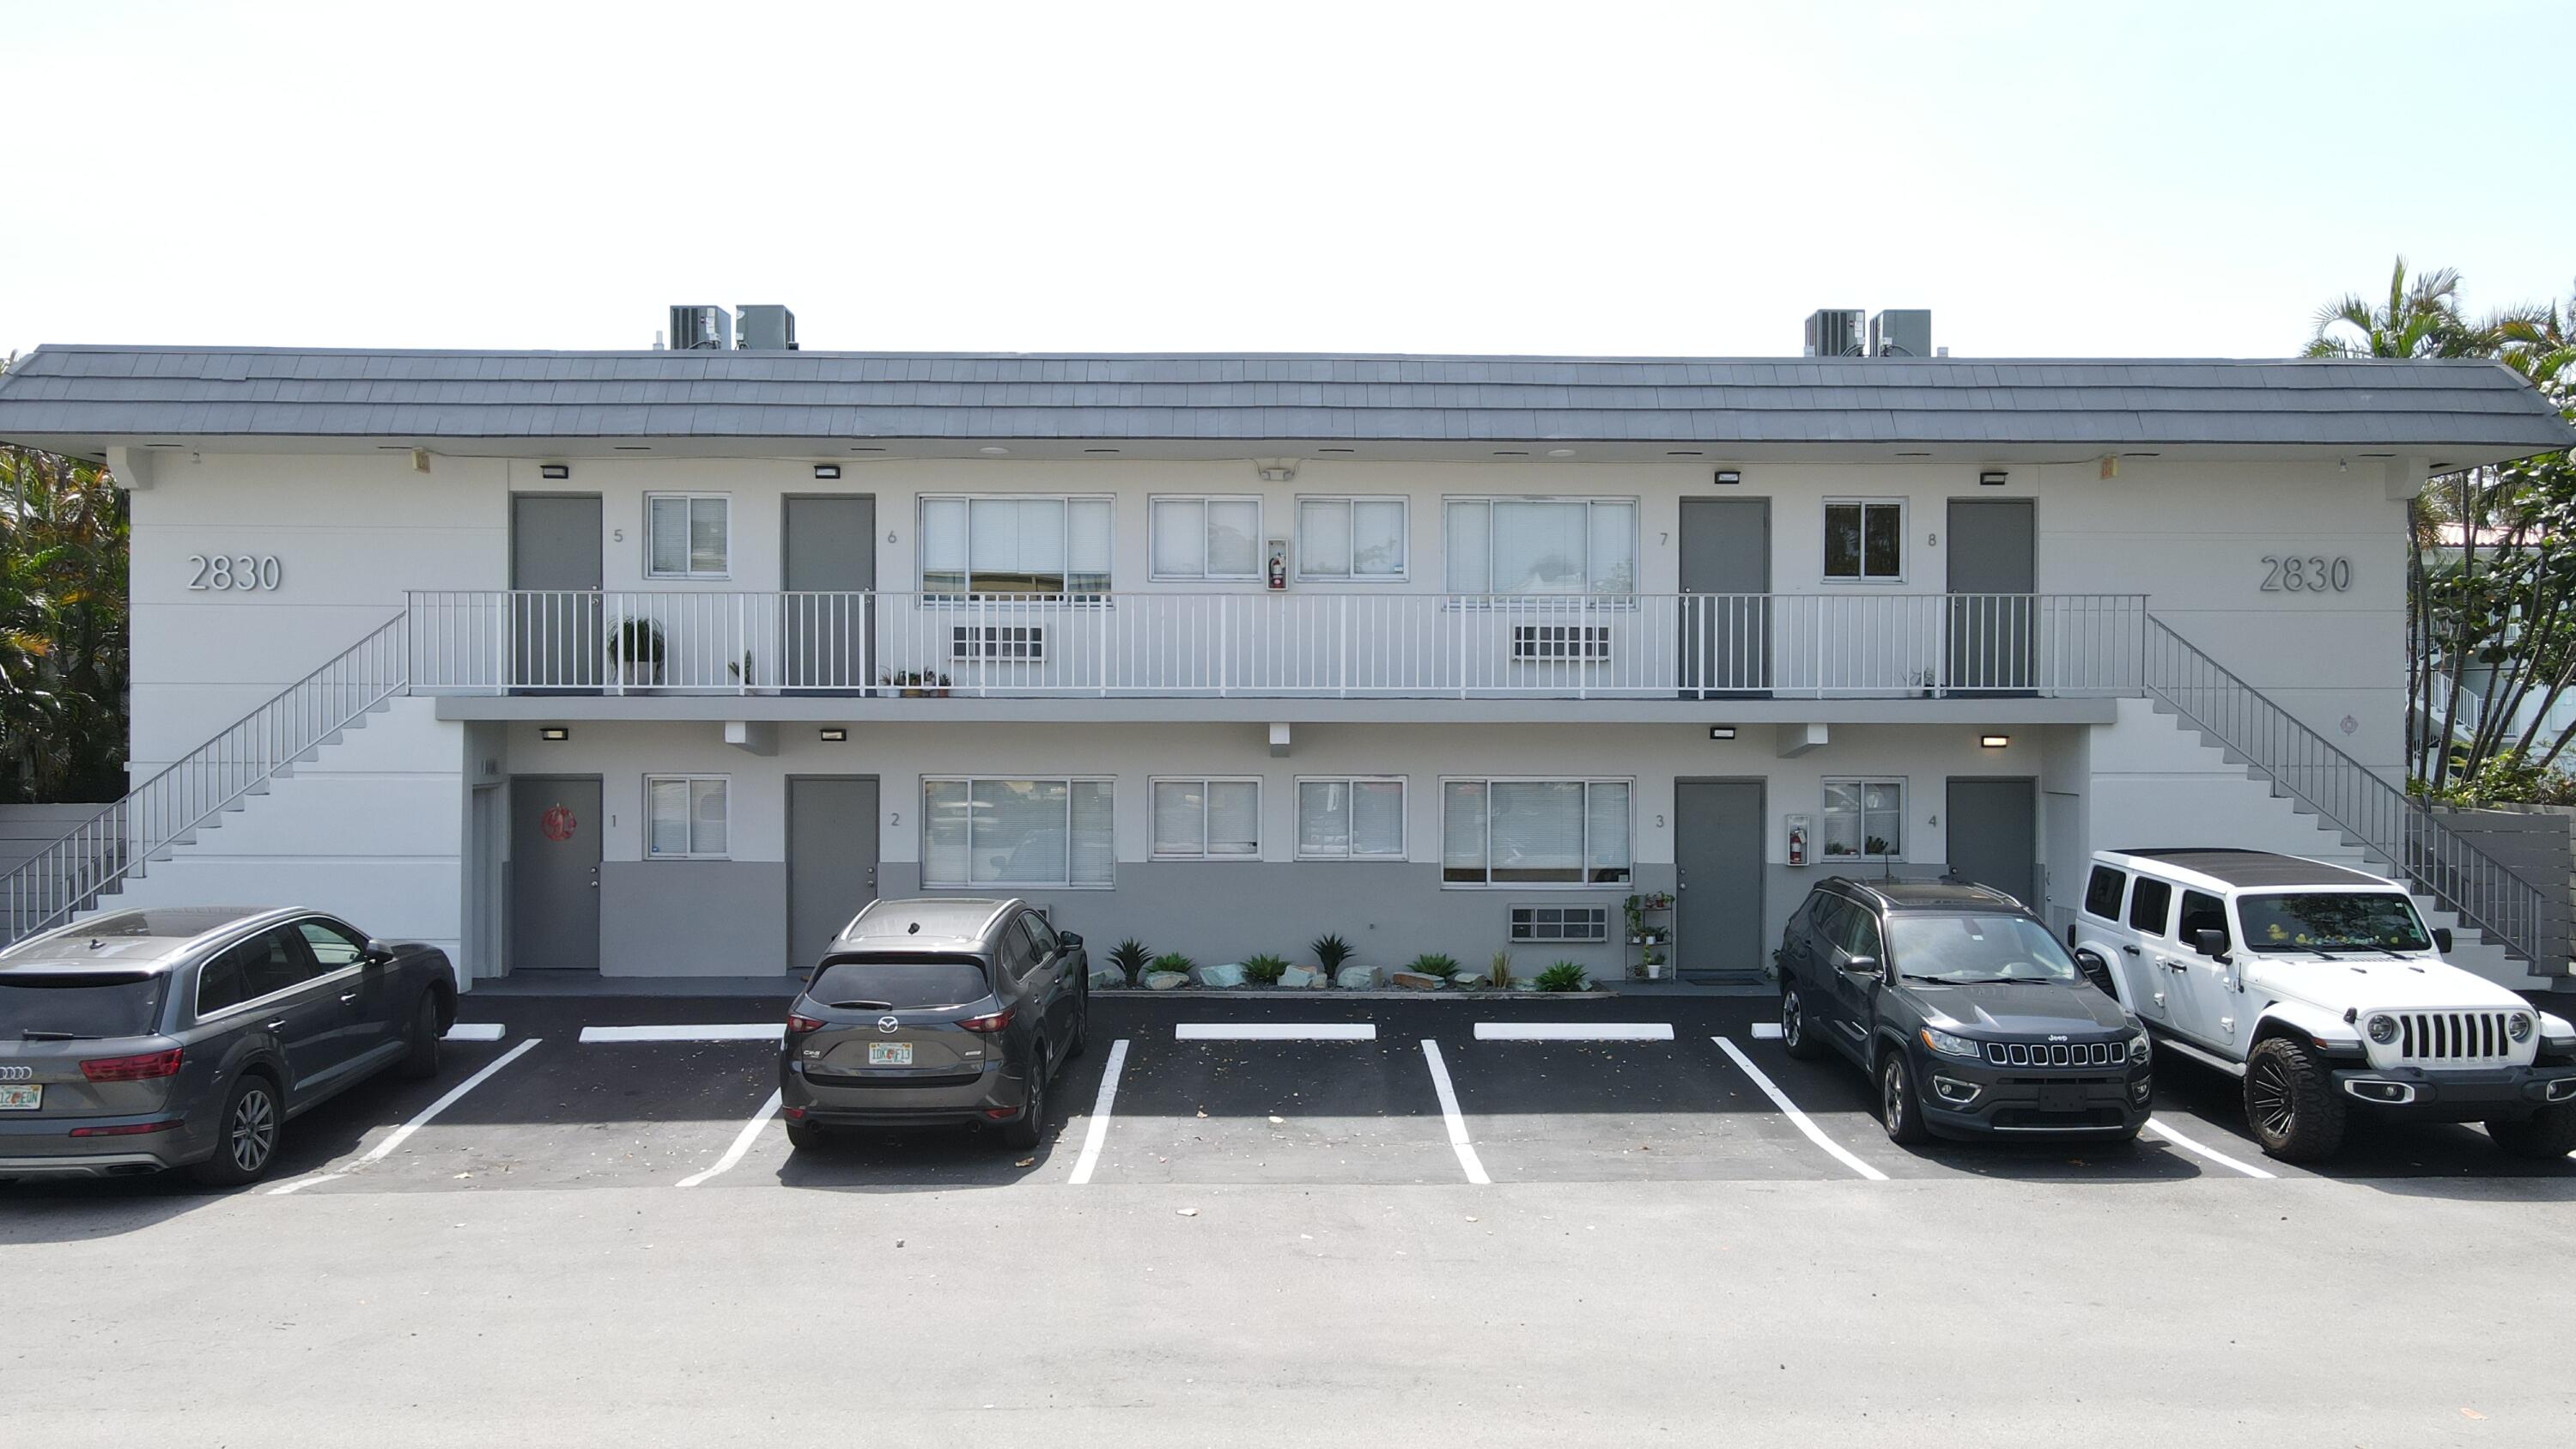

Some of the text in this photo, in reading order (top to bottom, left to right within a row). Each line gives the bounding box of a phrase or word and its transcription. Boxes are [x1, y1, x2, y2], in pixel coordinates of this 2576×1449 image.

[614, 528, 623, 543] 5
[887, 530, 897, 544] 6
[1659, 532, 1668, 546] 7
[1928, 533, 1938, 547] 8
[185, 554, 282, 591] 2830
[2259, 556, 2350, 592] 2830
[611, 814, 617, 827] 1
[891, 813, 900, 826] 2
[1656, 814, 1665, 828] 3
[1928, 815, 1938, 827] 4
[2048, 1034, 2068, 1043] Jeep
